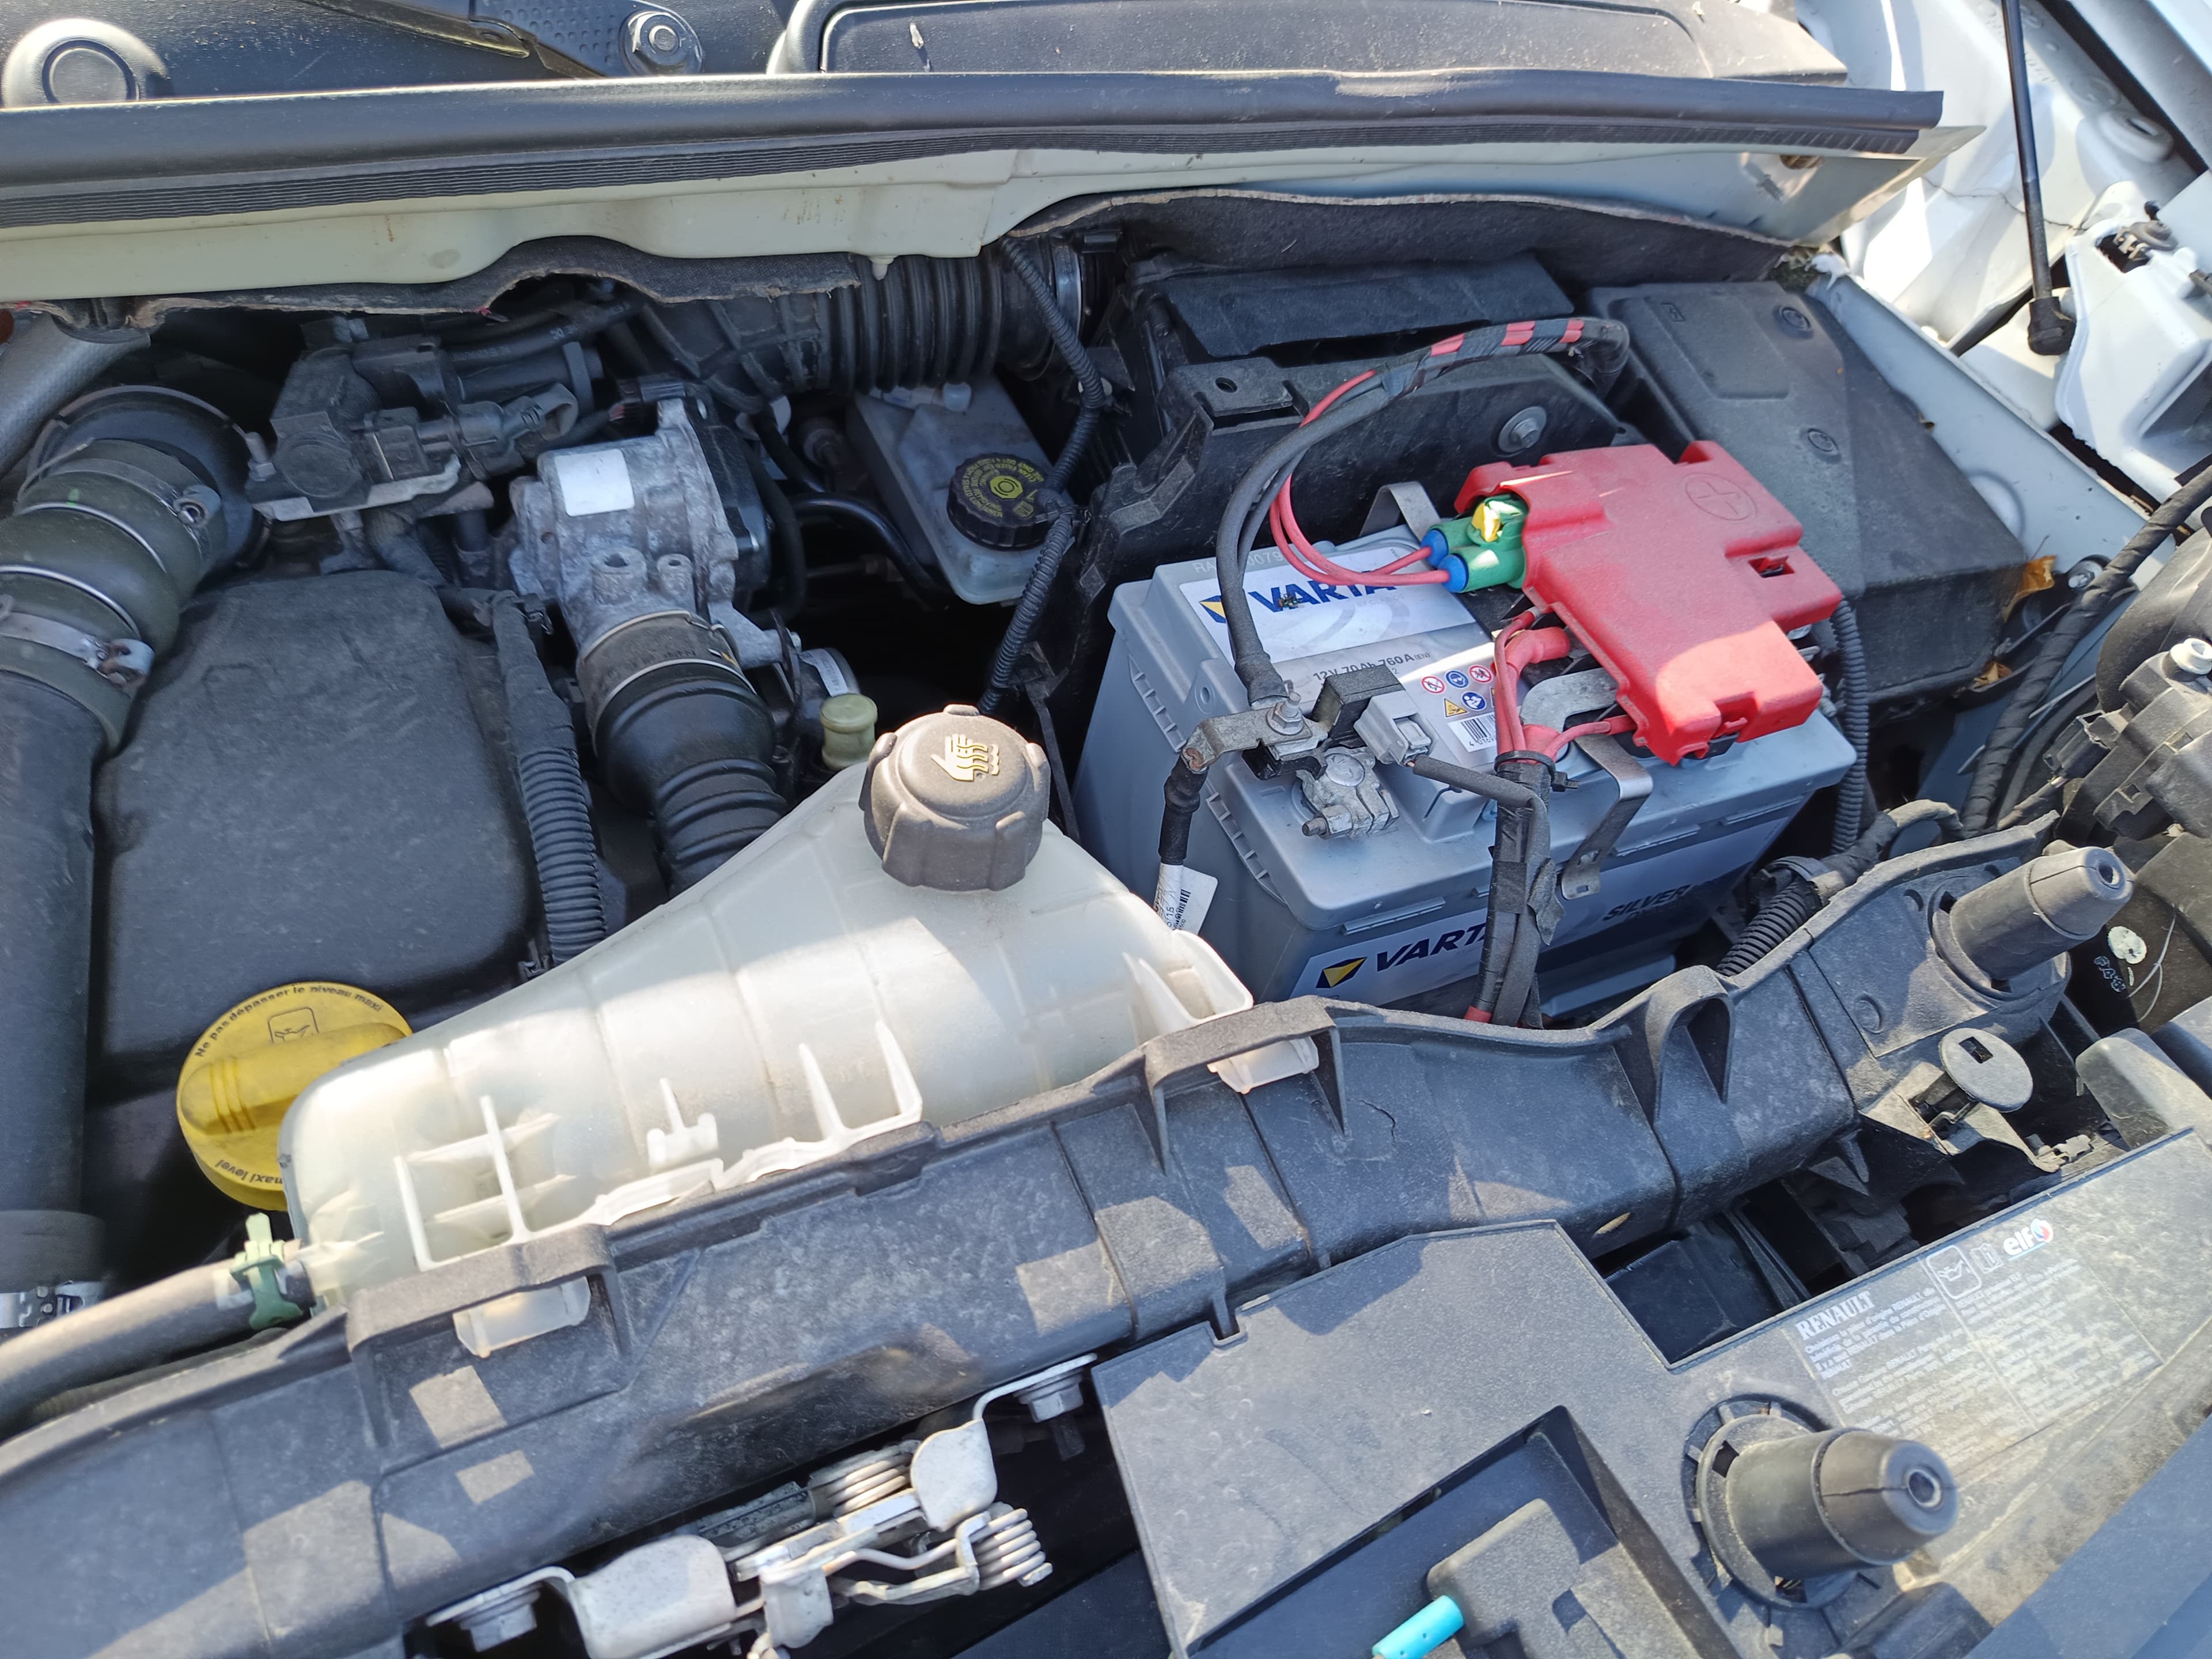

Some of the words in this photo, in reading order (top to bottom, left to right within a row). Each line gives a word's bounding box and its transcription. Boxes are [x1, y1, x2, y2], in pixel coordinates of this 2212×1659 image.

[1248, 570, 1396, 612] VAR
[1377, 923, 1486, 972] VART
[195, 1041, 211, 1058] Ne
[210, 1020, 229, 1041] pas
[230, 988, 291, 1021] dépasser
[292, 983, 306, 994] le
[310, 984, 352, 998] niveau
[354, 992, 385, 1013] maxi
[214, 1158, 247, 1183] level
[2003, 1226, 2035, 1256] elf
[1794, 1289, 1876, 1342] RENAULT
[1891, 1292, 1922, 1312] RENAULT
[1846, 1336, 1878, 1355] RENAULT
[1820, 1359, 1853, 1379] RENAULT
[1885, 1350, 1917, 1369] RENAULT
